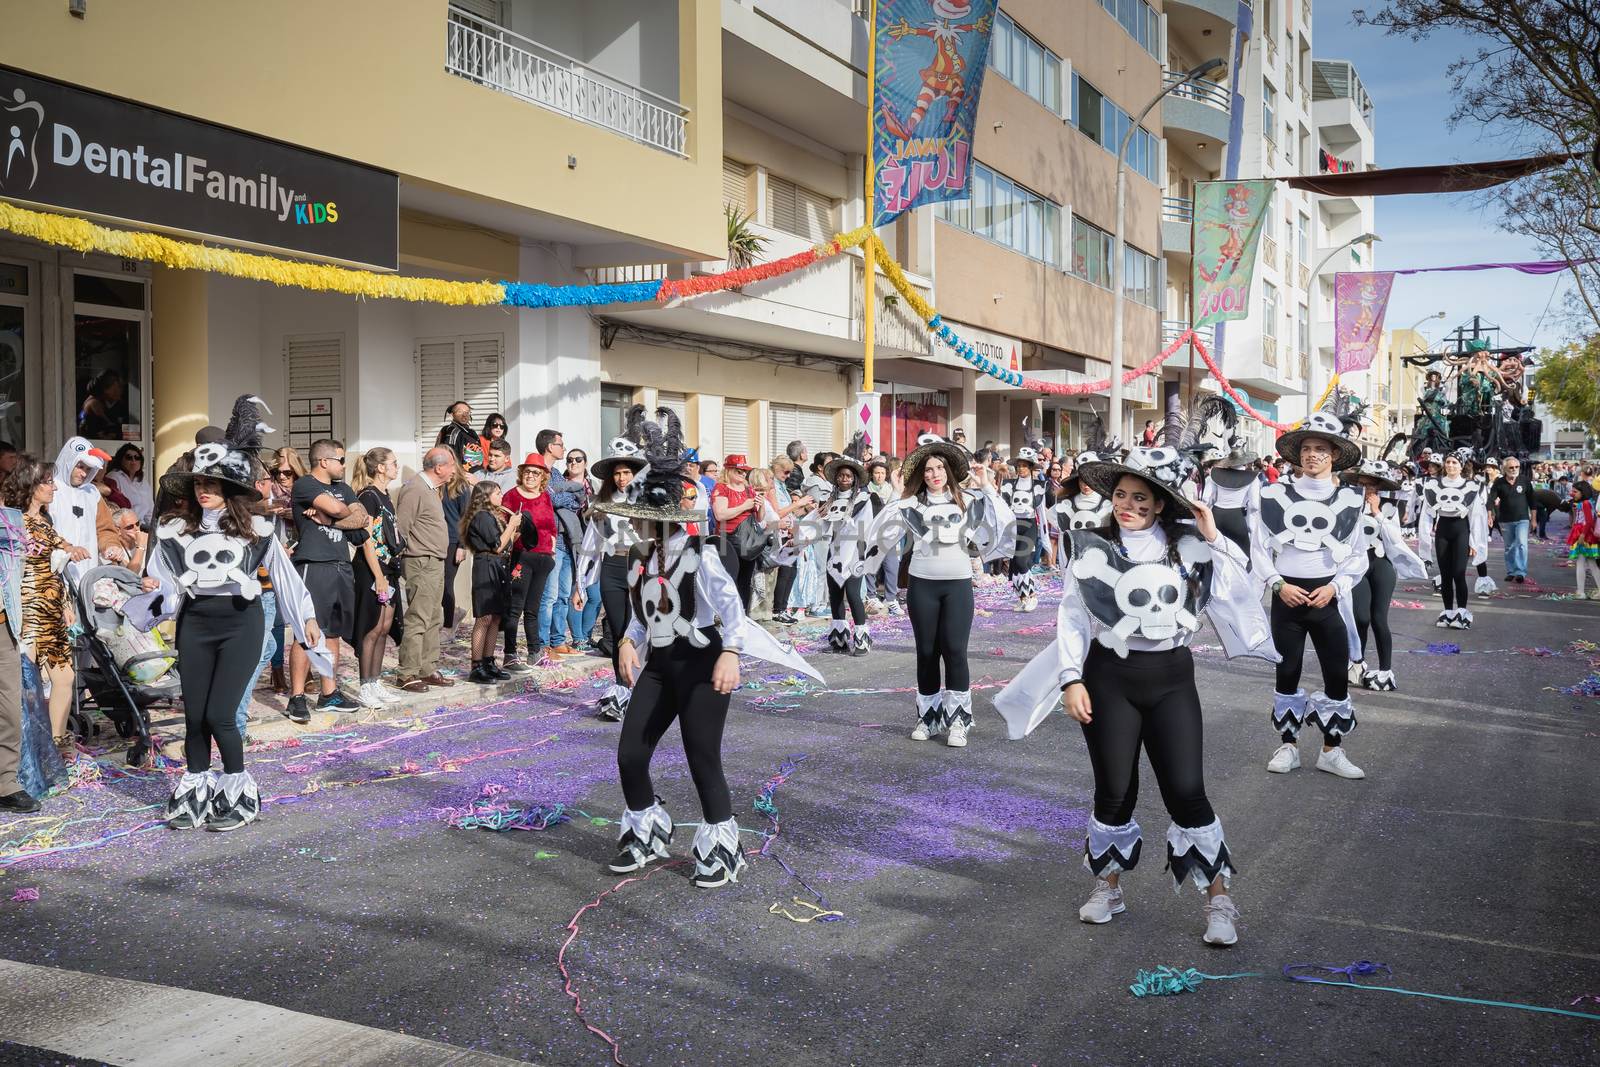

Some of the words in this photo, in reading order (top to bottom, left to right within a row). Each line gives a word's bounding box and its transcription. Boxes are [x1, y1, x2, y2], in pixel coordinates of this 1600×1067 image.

[53, 123, 295, 222] DentalFamily
[294, 193, 307, 202] and
[295, 202, 338, 225] KIDS
[121, 261, 137, 273] 155
[975, 341, 990, 357] TICO
[989, 344, 1004, 360] TICO
